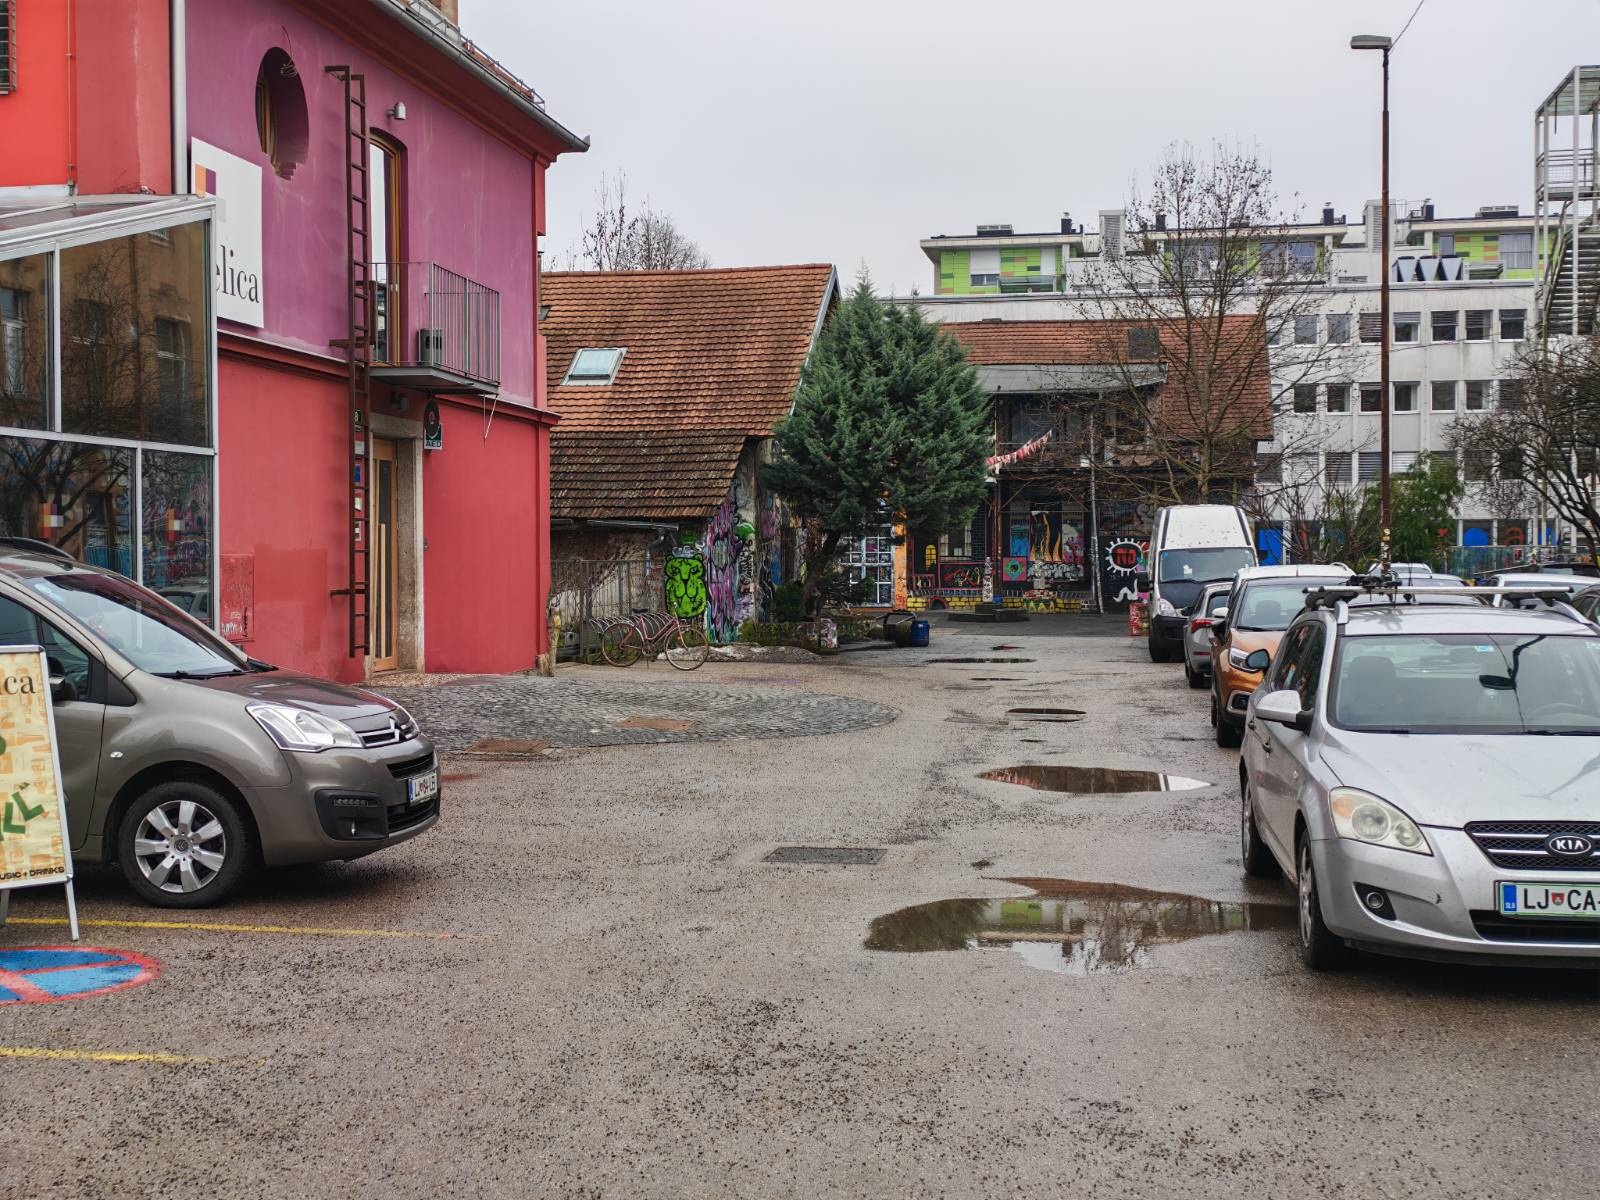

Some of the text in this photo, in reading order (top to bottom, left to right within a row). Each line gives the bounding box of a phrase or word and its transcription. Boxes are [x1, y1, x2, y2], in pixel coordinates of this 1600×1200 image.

[425, 440, 442, 448] AED
[0, 675, 37, 695] ca
[0, 792, 45, 841] LL
[1556, 839, 1584, 850] KIA
[0, 871, 22, 880] USIC
[29, 866, 65, 877] DRINKS
[1523, 888, 1549, 910] LJ
